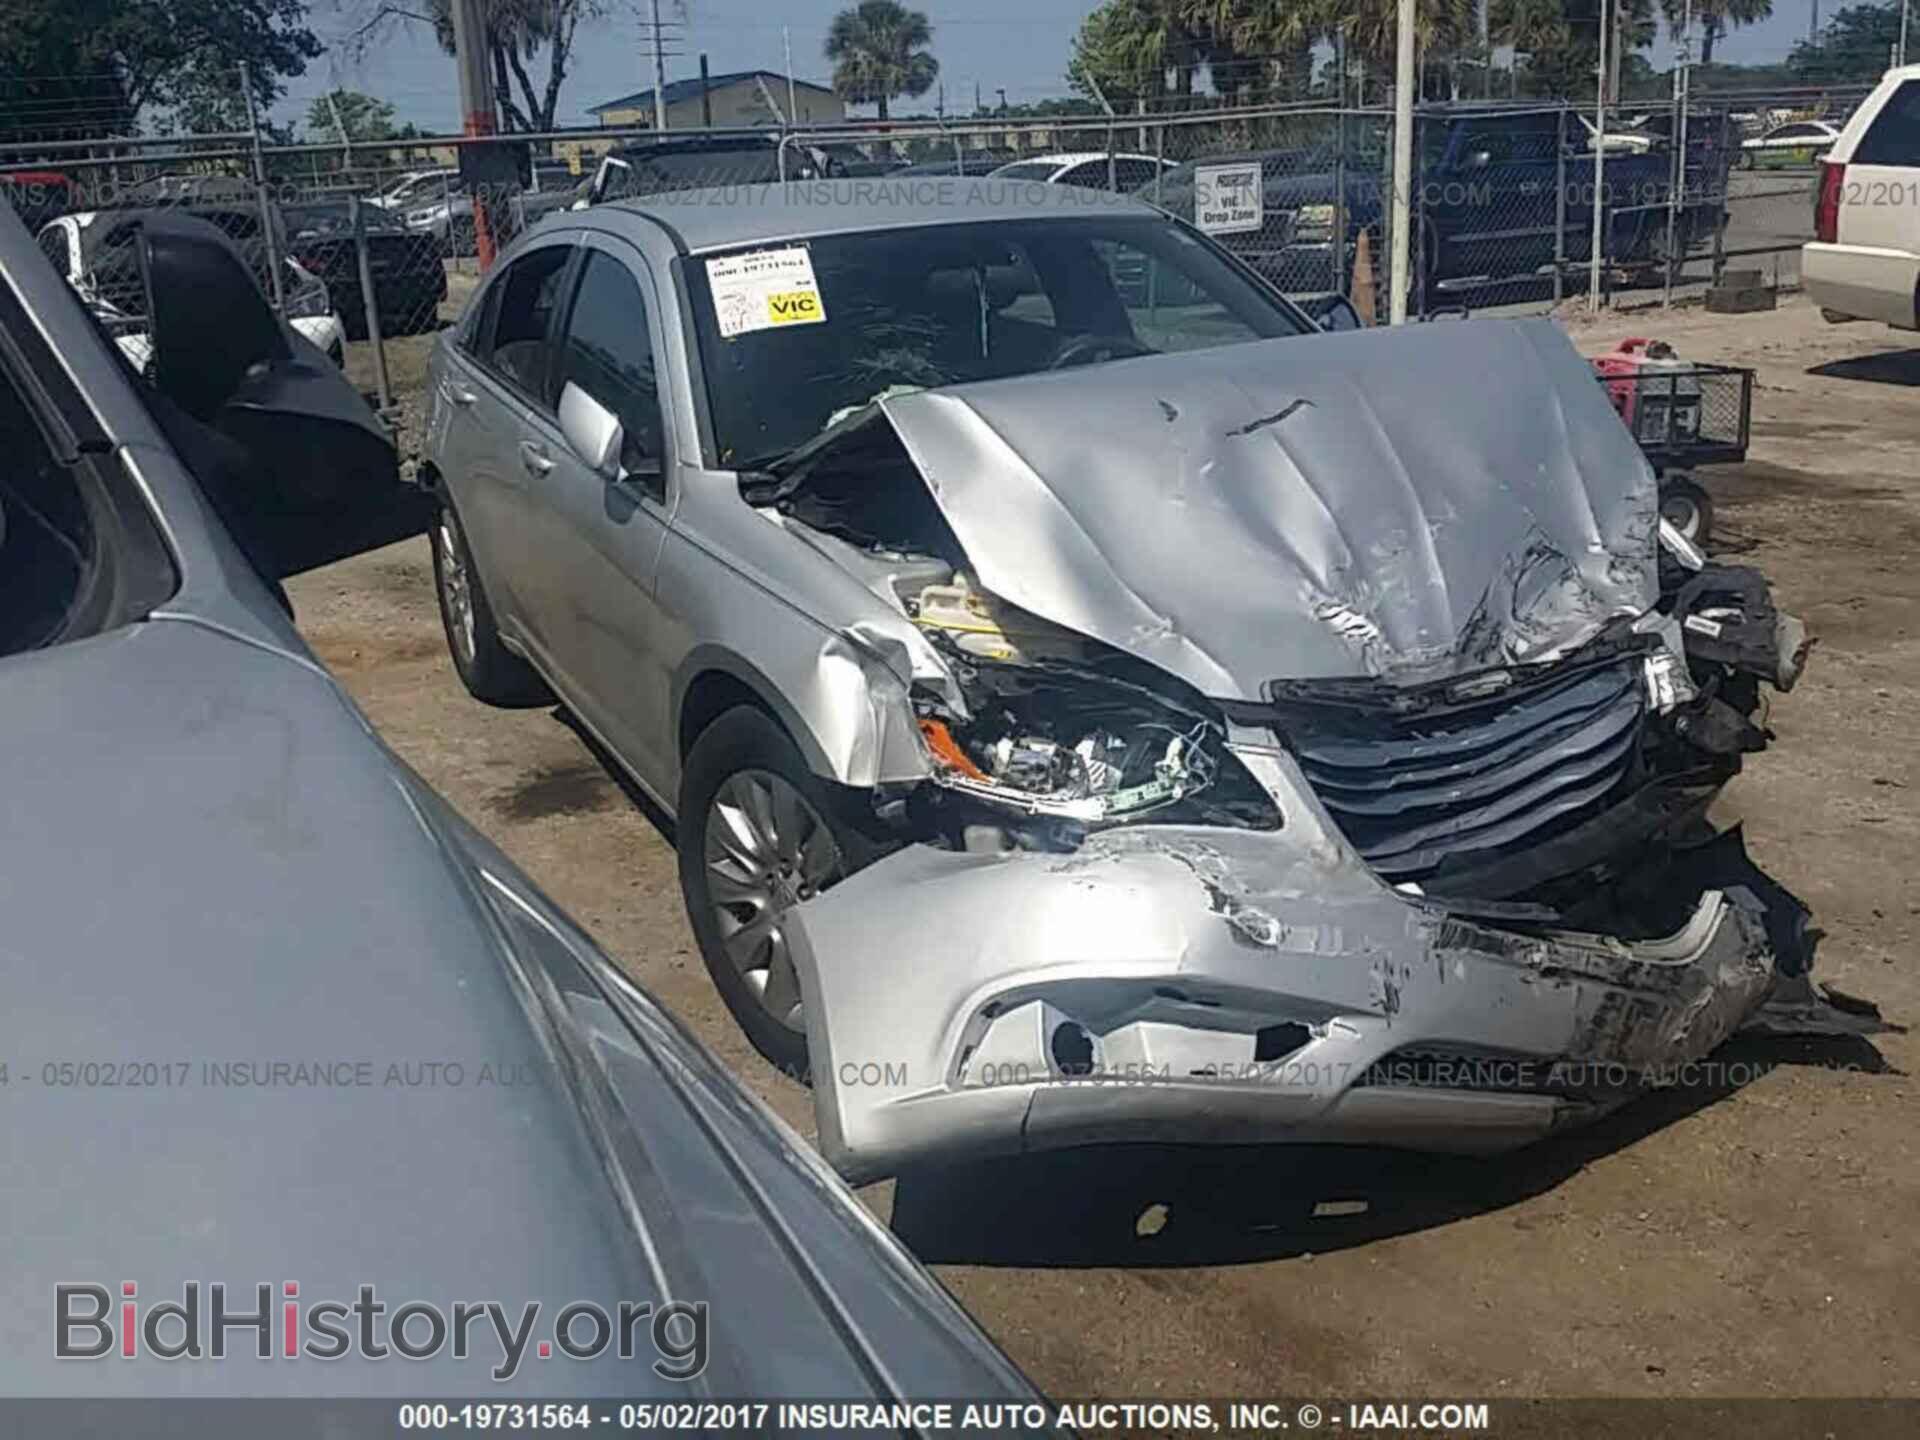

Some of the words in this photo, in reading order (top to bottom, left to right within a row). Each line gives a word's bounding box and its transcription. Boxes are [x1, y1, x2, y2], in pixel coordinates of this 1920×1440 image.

[1221, 196, 1239, 209] VIC
[1204, 212, 1229, 224] Drop
[771, 299, 815, 314] VIC
